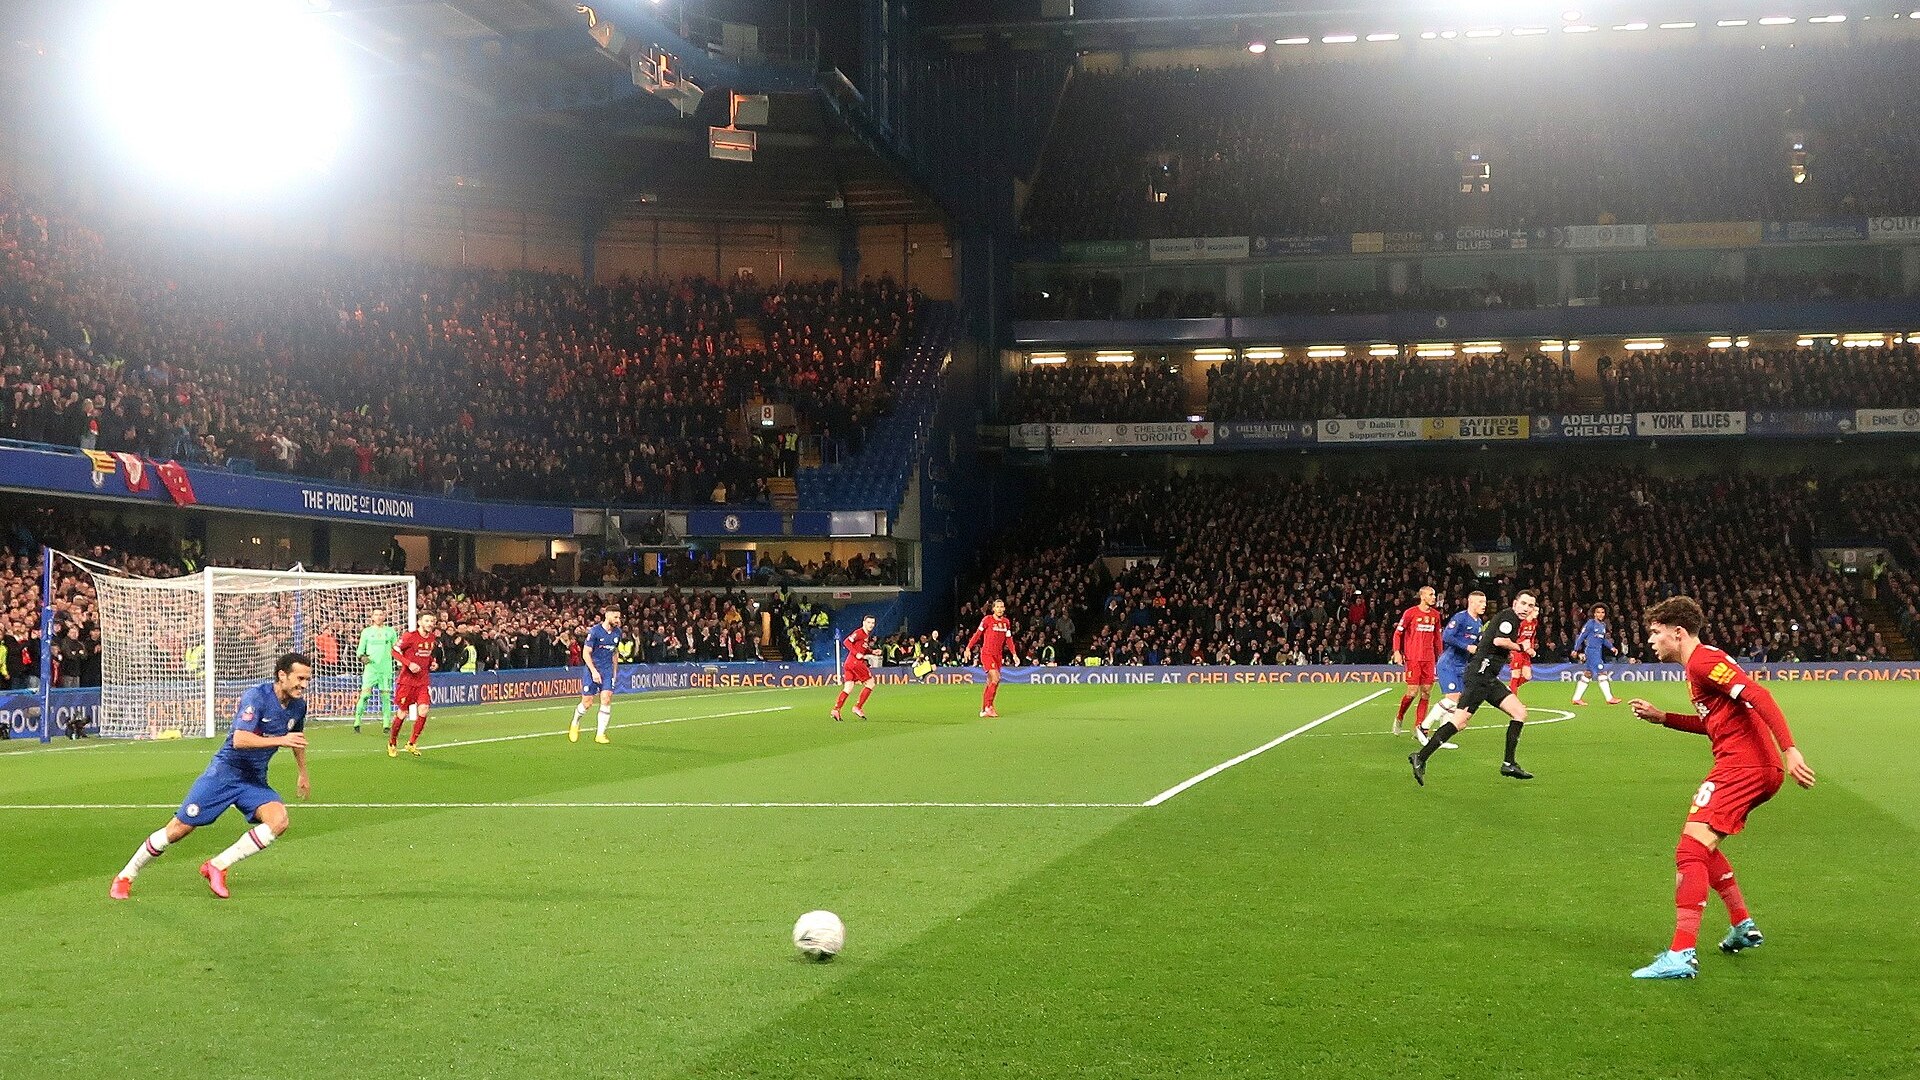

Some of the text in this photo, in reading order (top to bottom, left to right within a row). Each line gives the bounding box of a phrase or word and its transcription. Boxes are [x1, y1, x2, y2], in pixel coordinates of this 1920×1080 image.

[1456, 229, 1509, 239] CORNISH
[1456, 240, 1491, 250] BLUES
[764, 407, 771, 418] 8
[1459, 418, 1518, 427] SAFFRON
[1561, 413, 1632, 425] ADELAIDE
[1652, 413, 1730, 429] YORK BLUES
[1134, 425, 1187, 433] CHELSEA FC
[1398, 430, 1417, 438] Club
[1459, 426, 1519, 437] BLUES
[1564, 424, 1631, 437] CHELSEA
[1134, 433, 1187, 442] TORONTO
[302, 490, 414, 518] THE PRIDE OF LONDON
[631, 675, 650, 689] BOOK
[652, 674, 678, 687] ONLINE
[678, 673, 688, 686] AT
[1030, 673, 1081, 684] BOOK
[1087, 673, 1154, 684] ONLINE
[1161, 673, 1181, 684] AT
[1561, 671, 1614, 682] BOK
[430, 685, 466, 704] ONLINE
[468, 684, 479, 702] AT
